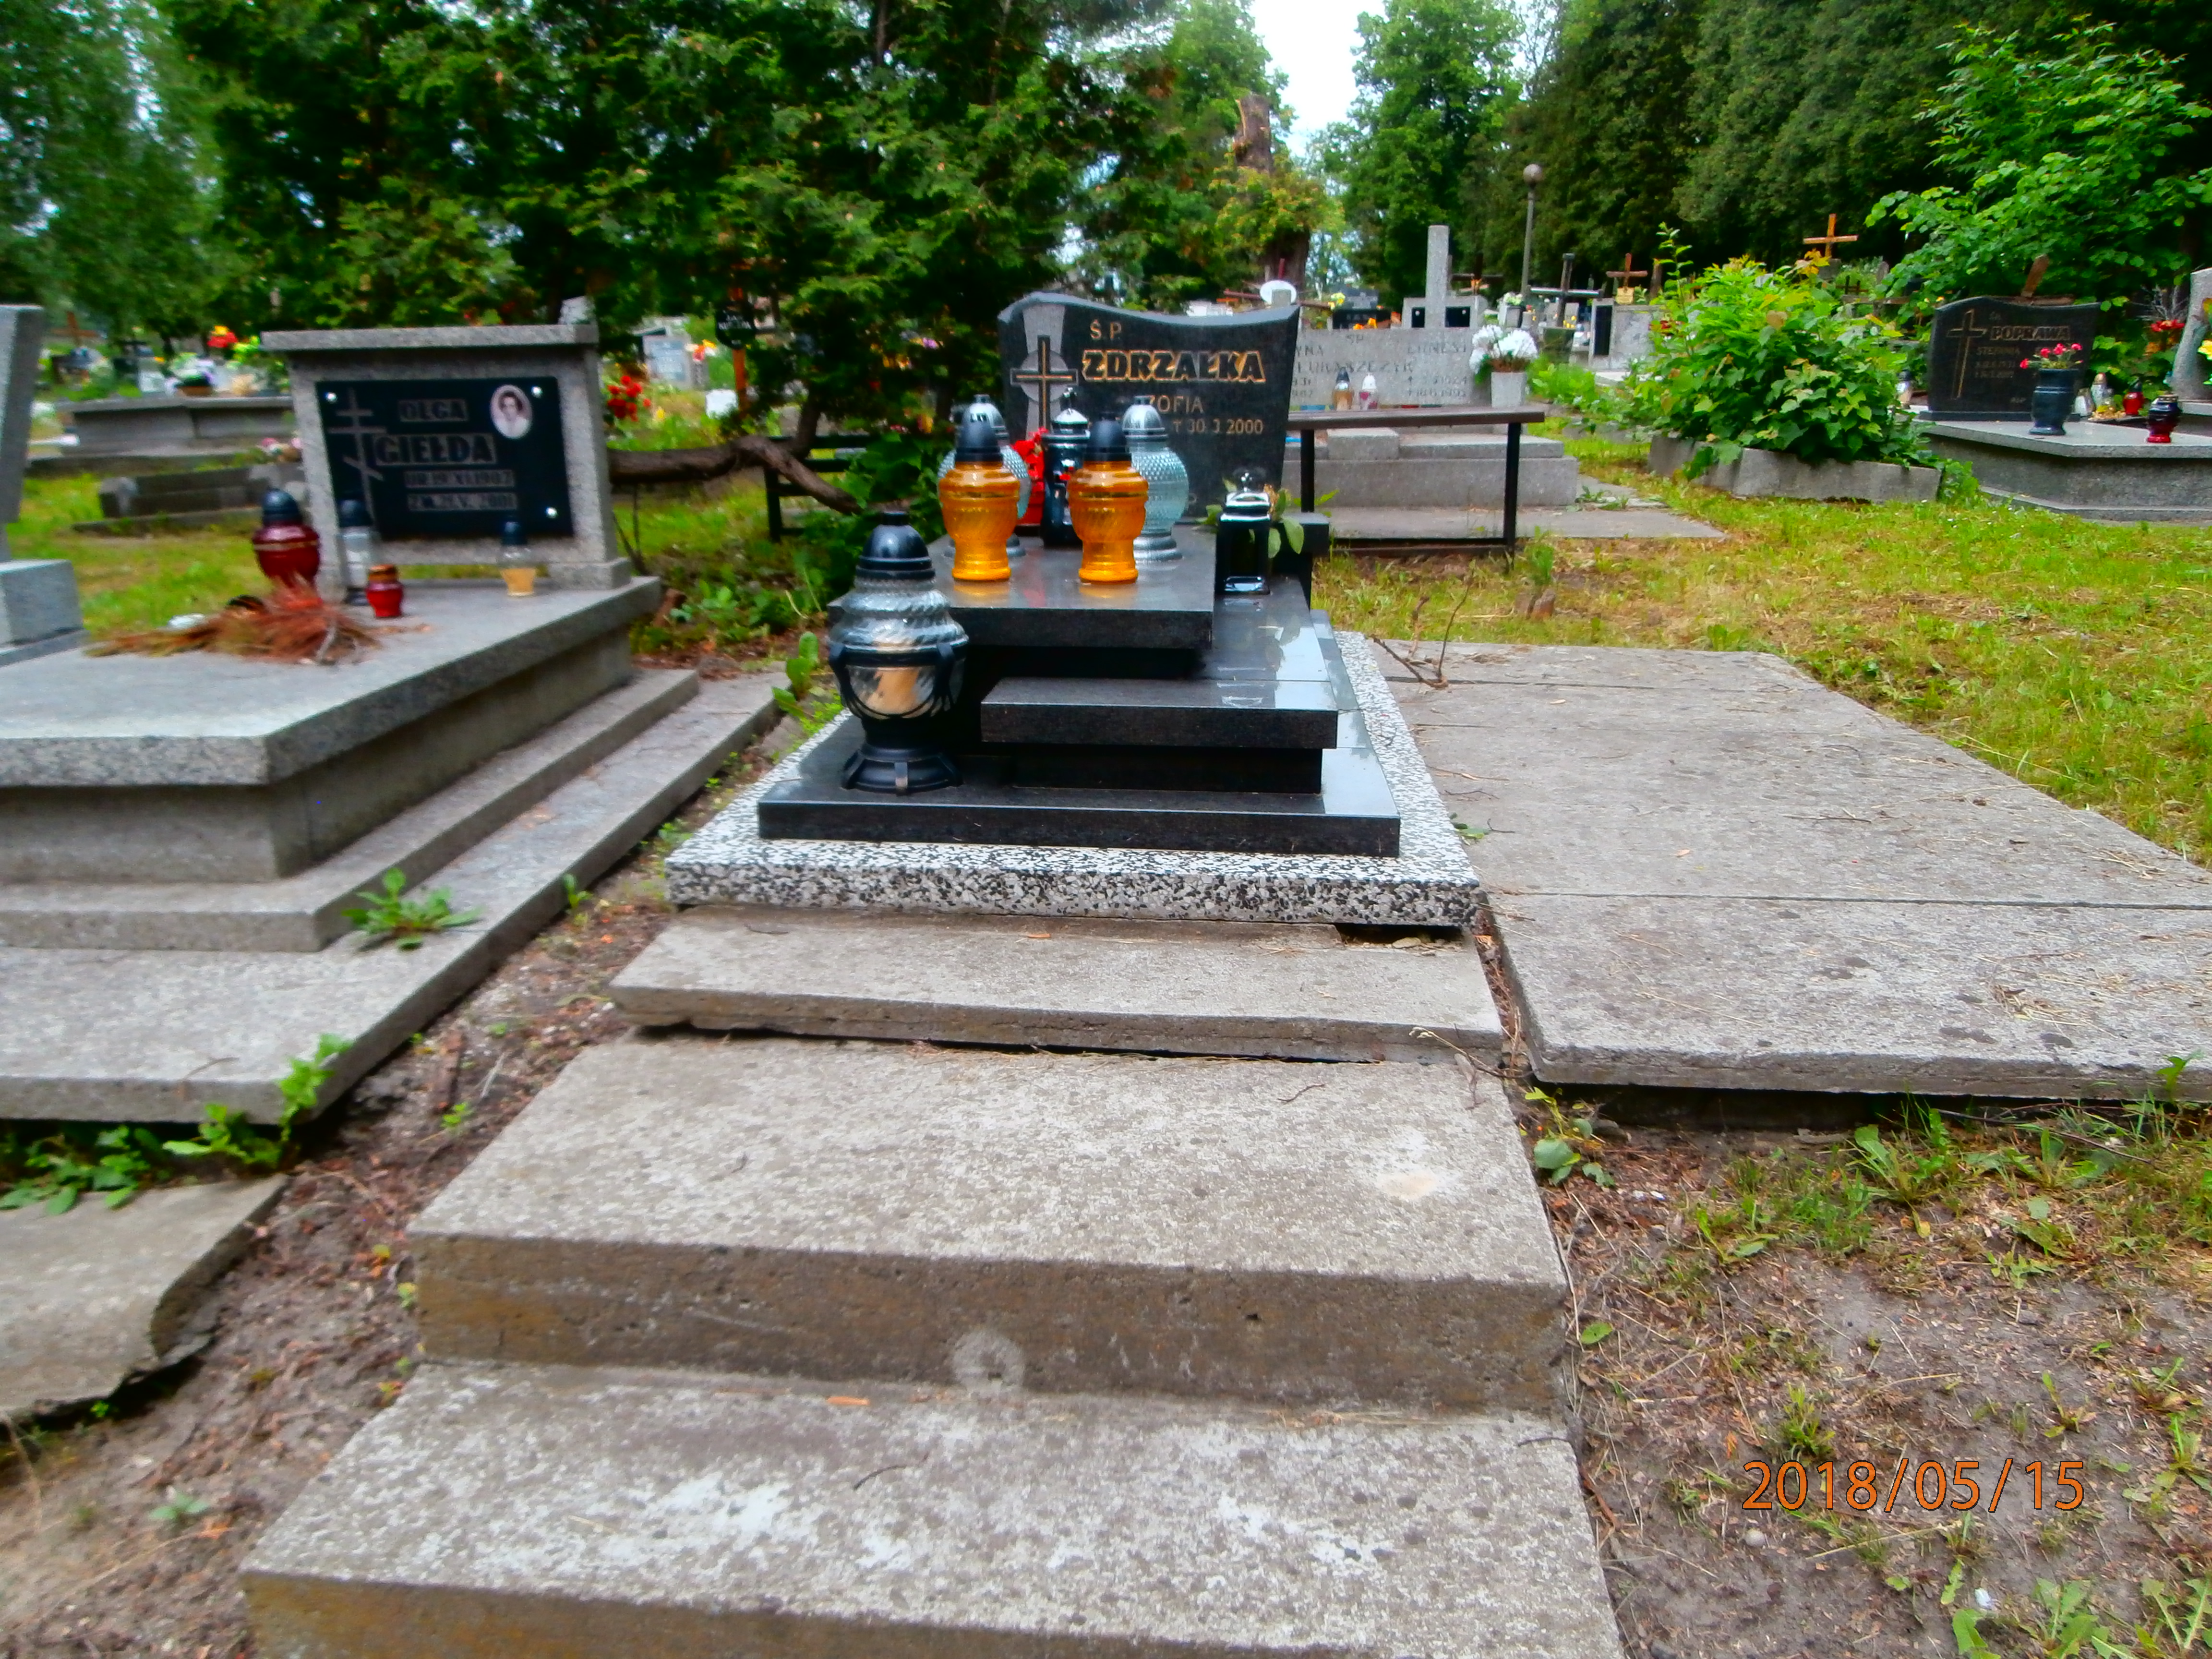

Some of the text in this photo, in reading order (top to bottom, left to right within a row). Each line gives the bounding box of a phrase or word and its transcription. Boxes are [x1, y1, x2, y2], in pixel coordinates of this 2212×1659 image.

[1990, 325, 2070, 341] POPRAWA
[1082, 349, 1267, 384] ZDRZAŁKA
[398, 398, 469, 422] OLGA
[1226, 419, 1264, 435] 2000
[373, 433, 497, 467] GIEŁDA
